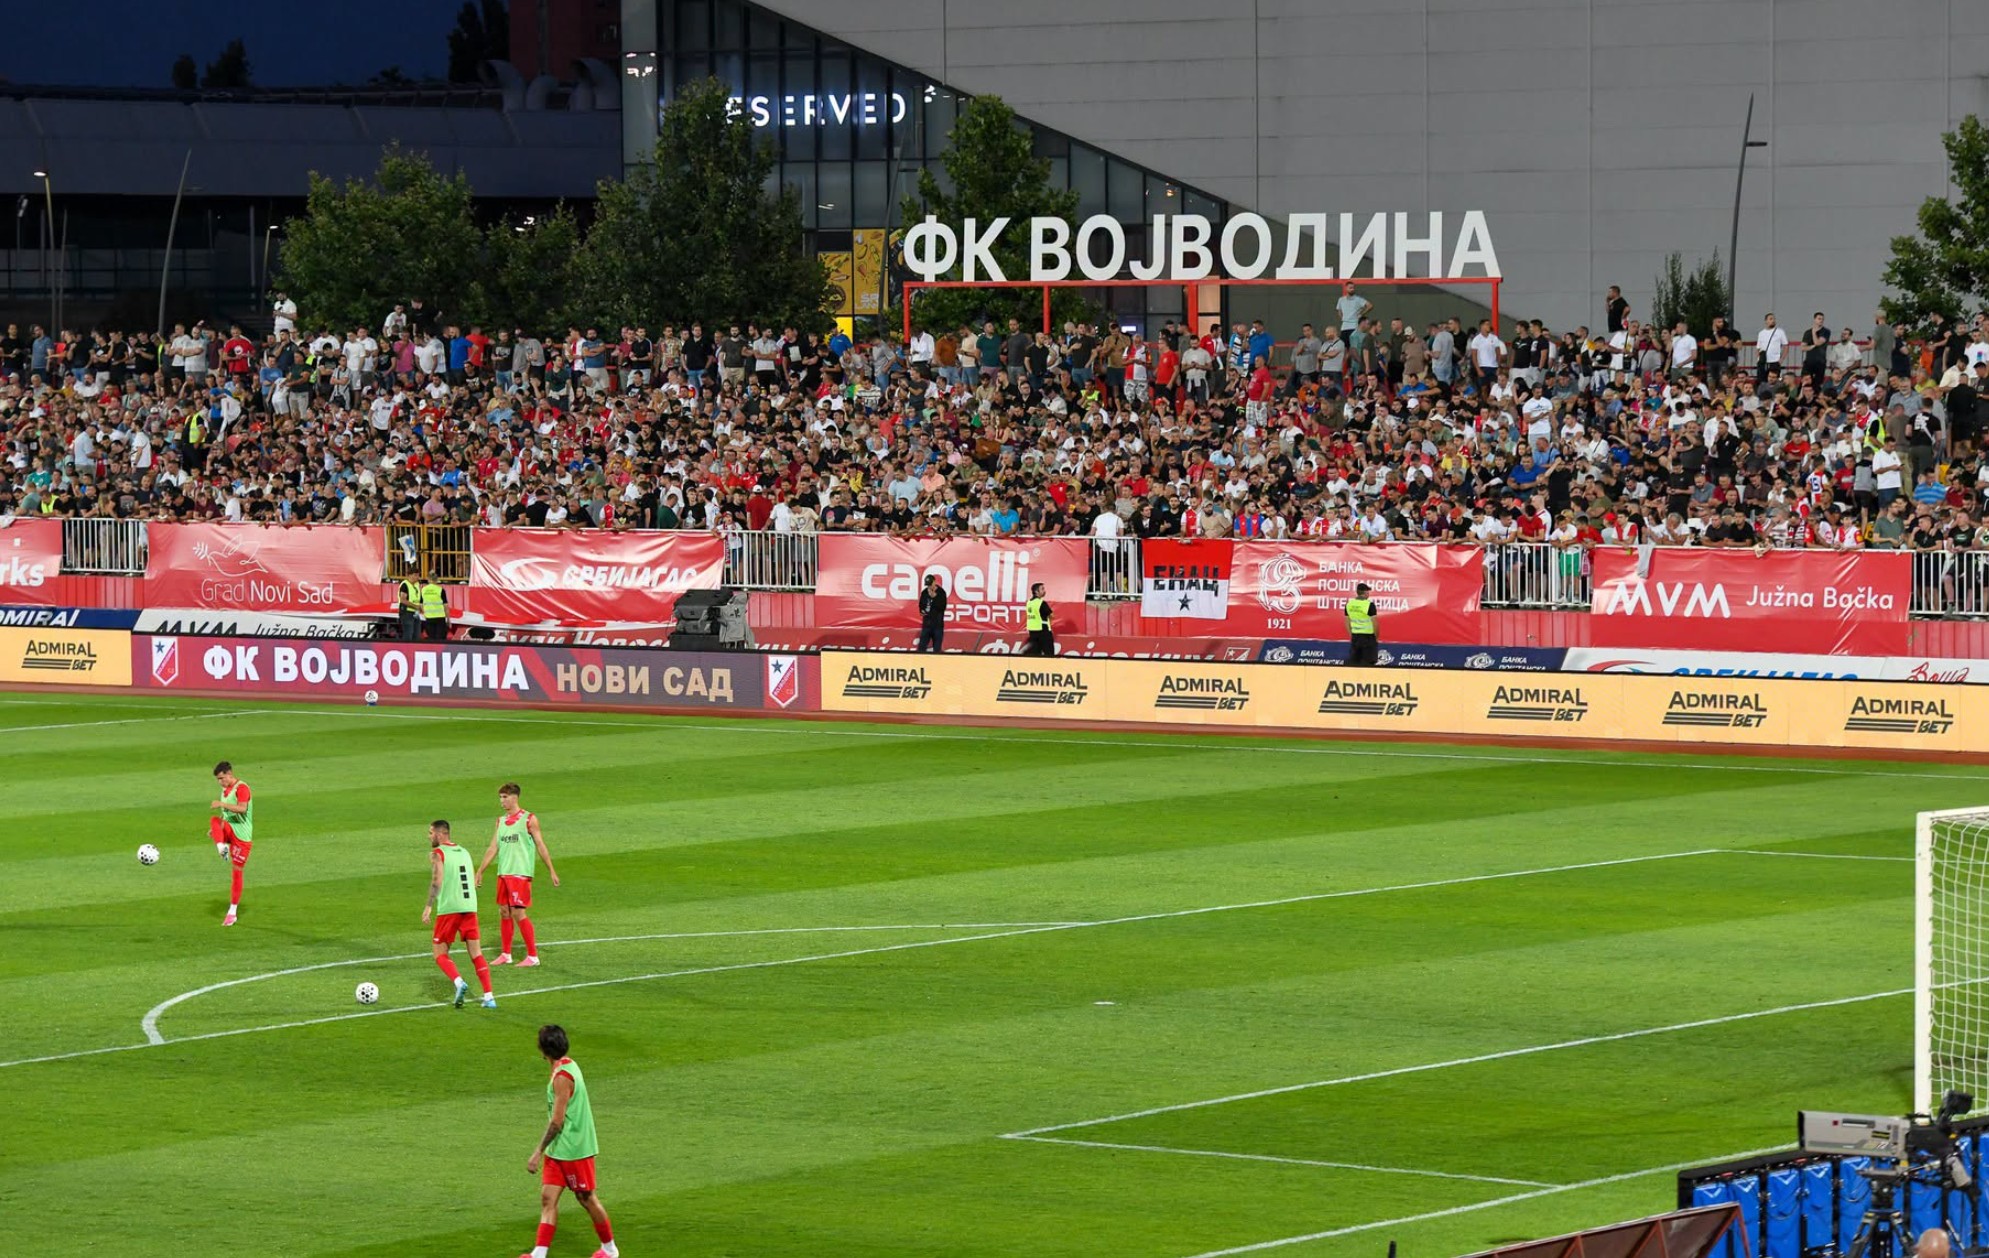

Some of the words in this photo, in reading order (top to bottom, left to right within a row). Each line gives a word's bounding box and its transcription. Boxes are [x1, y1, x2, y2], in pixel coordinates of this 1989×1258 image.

[904, 214, 1008, 282] ФК
[1030, 210, 1502, 282] ВОЈВОДИНА
[562, 564, 698, 587] СРБИЈАГАС
[1318, 561, 1364, 574] БАНКА
[201, 578, 245, 601] Grad
[250, 580, 291, 603] Novi
[297, 581, 333, 604] Sad
[1317, 579, 1400, 592] ПОШТНСКА
[1316, 596, 1410, 612] ШТЕНИЦА
[1606, 582, 1731, 618] MVM
[1746, 585, 1814, 608] Južna
[1822, 586, 1894, 610] Bačka
[943, 604, 1027, 624] SPORT
[1267, 618, 1291, 630] 1921
[25, 640, 97, 657] ADMIRAL
[71, 659, 97, 671] BET
[203, 645, 260, 681] ФК
[274, 646, 530, 694] ВОЈВОДИНА
[557, 663, 650, 695] НОВИ
[663, 667, 734, 703] САД
[847, 665, 932, 685] ADMIRAL
[1001, 670, 1088, 690] ADMIRAL
[900, 686, 932, 699] BET
[1159, 675, 1249, 696] ADMIRAL
[1324, 680, 1419, 701] ADMIRAL
[1056, 691, 1088, 705] BET
[1217, 697, 1249, 711] BET
[1493, 685, 1588, 706] ADMIRAL
[1668, 691, 1768, 712] ADMIRAL
[1384, 702, 1419, 716] BET
[1554, 707, 1588, 722] BET
[1851, 696, 1954, 718] ADMIRAL
[1733, 714, 1768, 728] BET
[1916, 720, 1954, 734] BET
